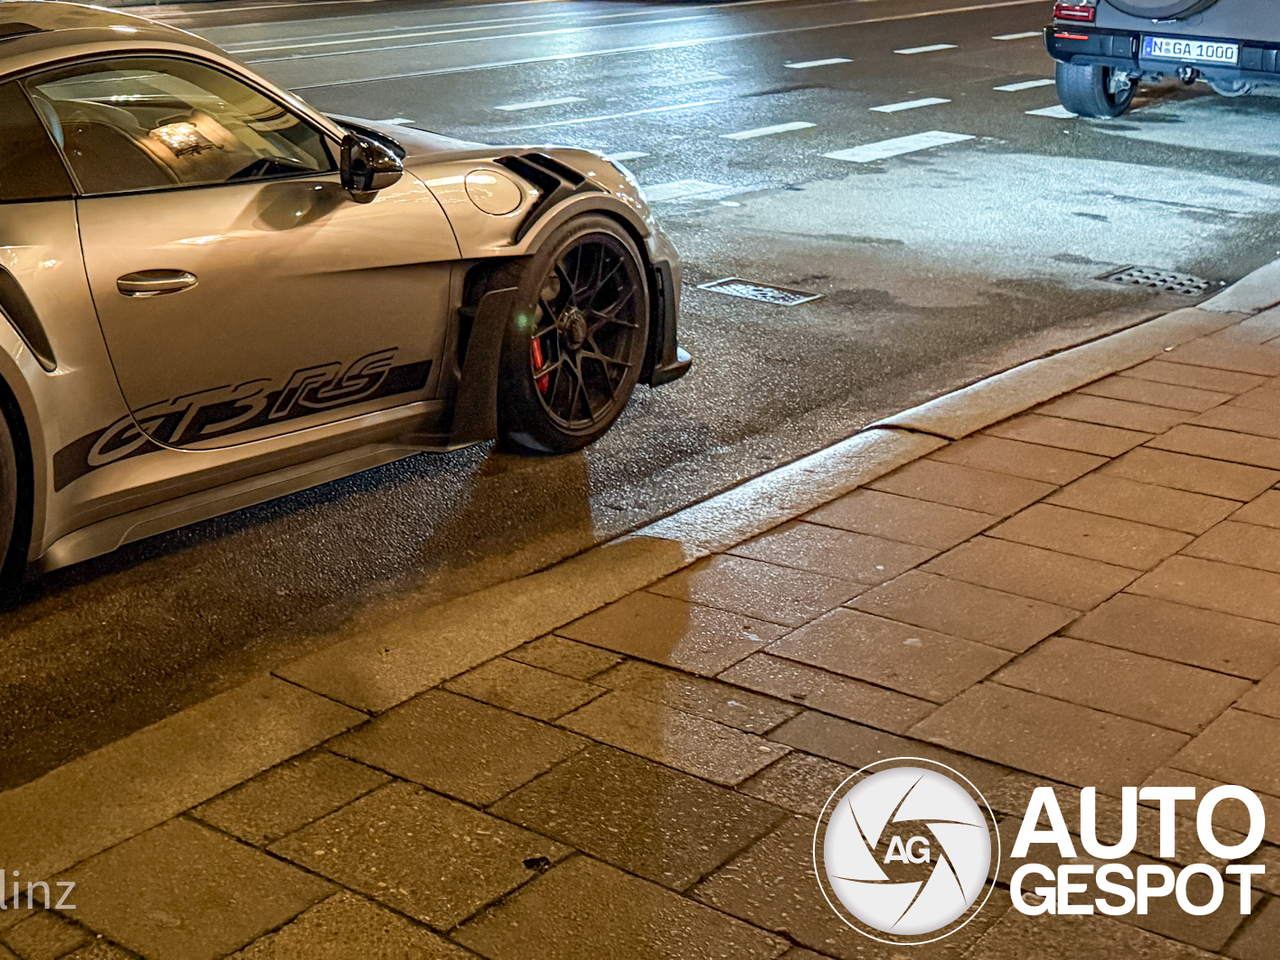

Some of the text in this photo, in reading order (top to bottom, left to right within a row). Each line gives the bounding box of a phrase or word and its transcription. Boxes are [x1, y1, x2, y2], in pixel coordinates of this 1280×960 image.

[1153, 40, 1234, 60] N GA 1000
